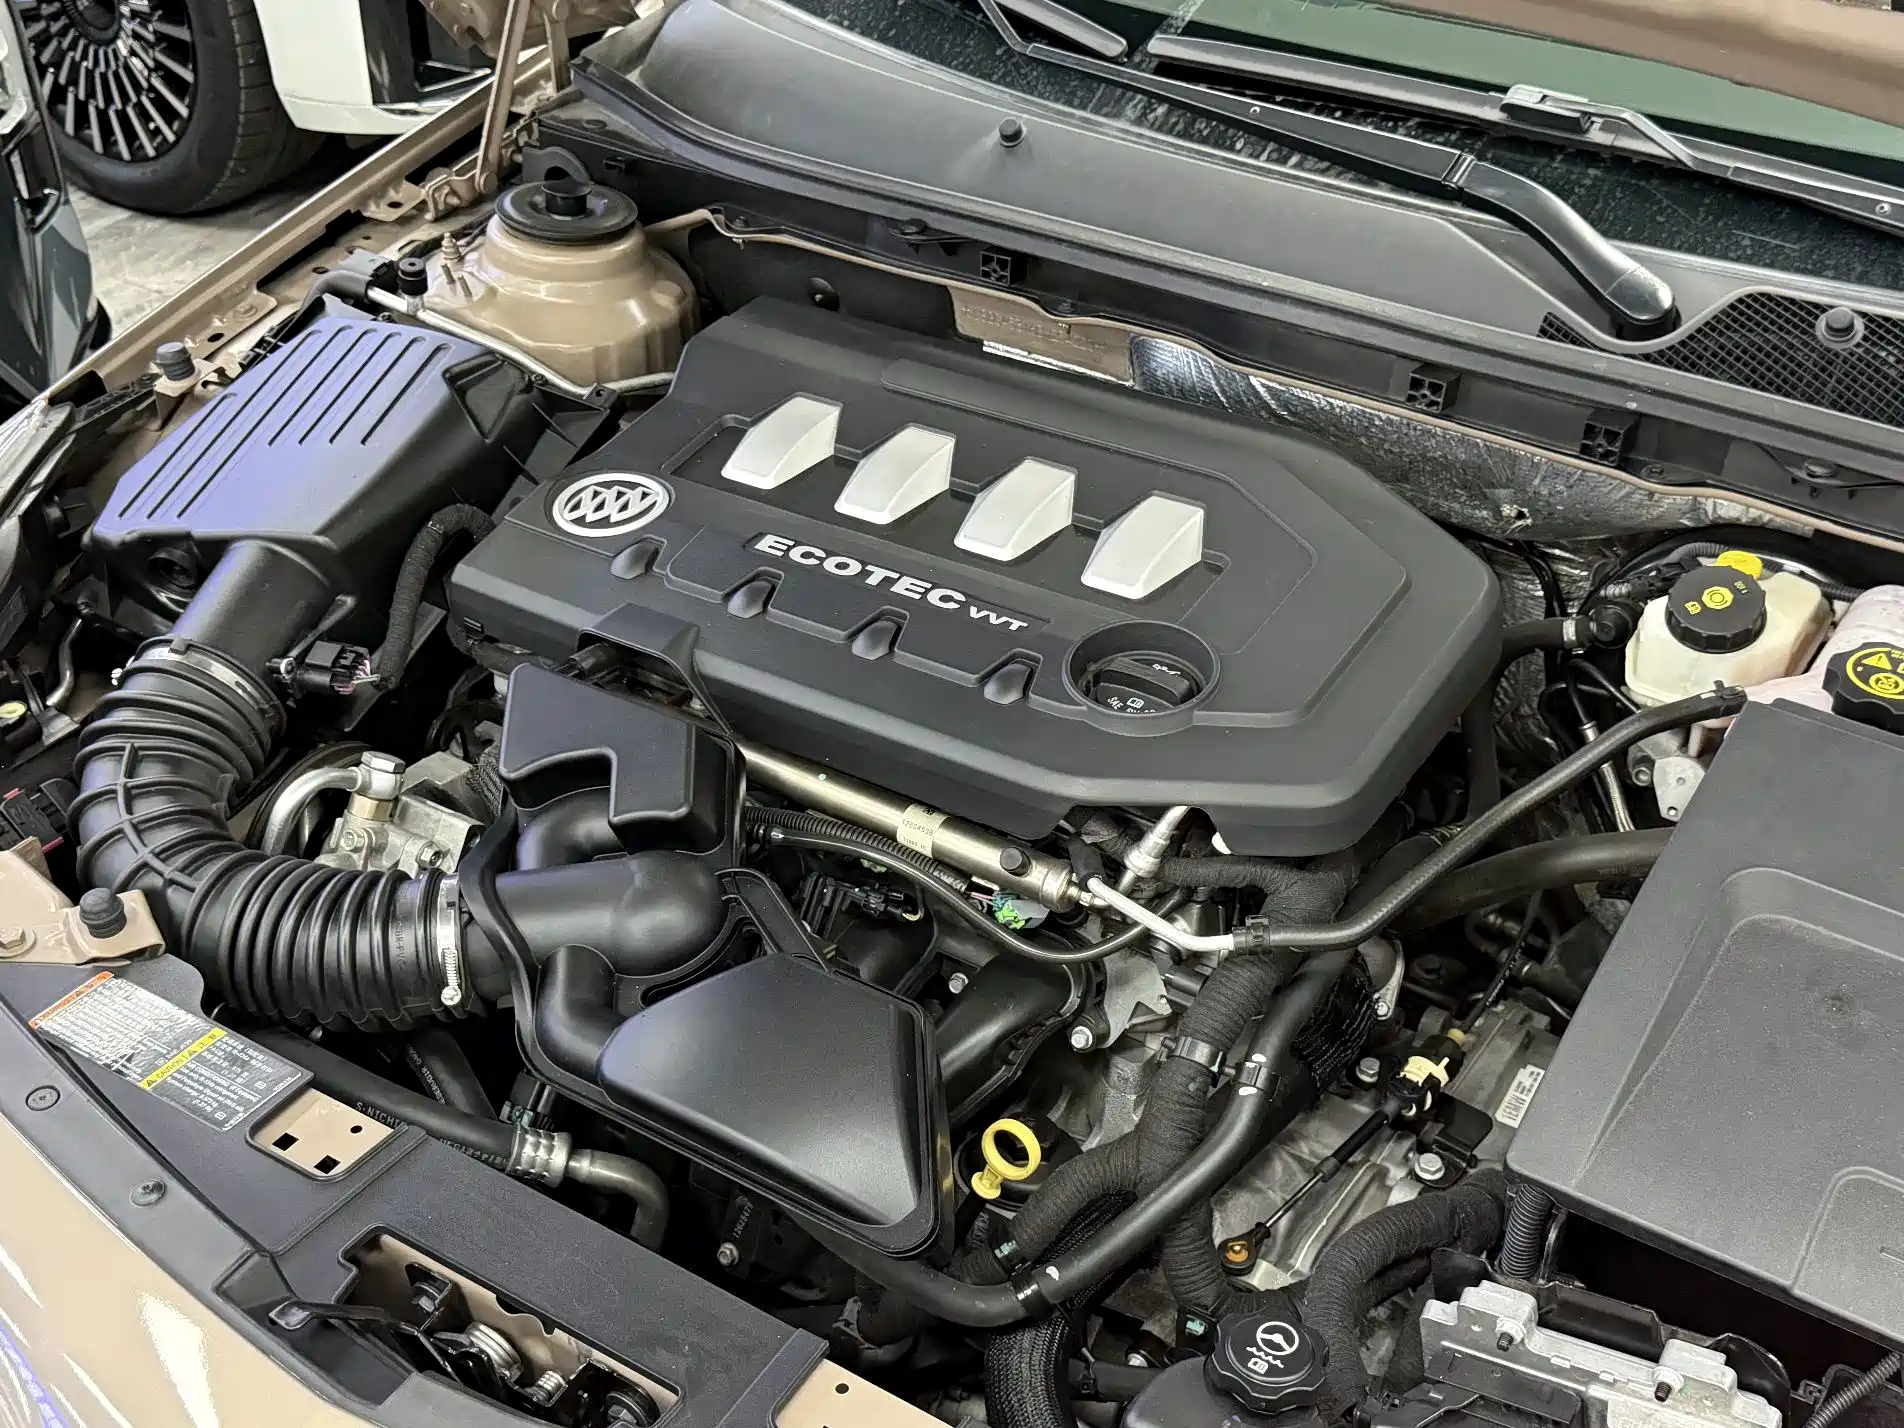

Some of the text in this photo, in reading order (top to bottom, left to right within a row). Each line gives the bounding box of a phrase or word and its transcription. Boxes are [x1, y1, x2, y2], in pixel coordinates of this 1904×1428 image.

[754, 534, 1028, 631] ECOTEC VVT
[1107, 697, 1123, 710] SAE
[156, 1059, 184, 1079] CAUTION
